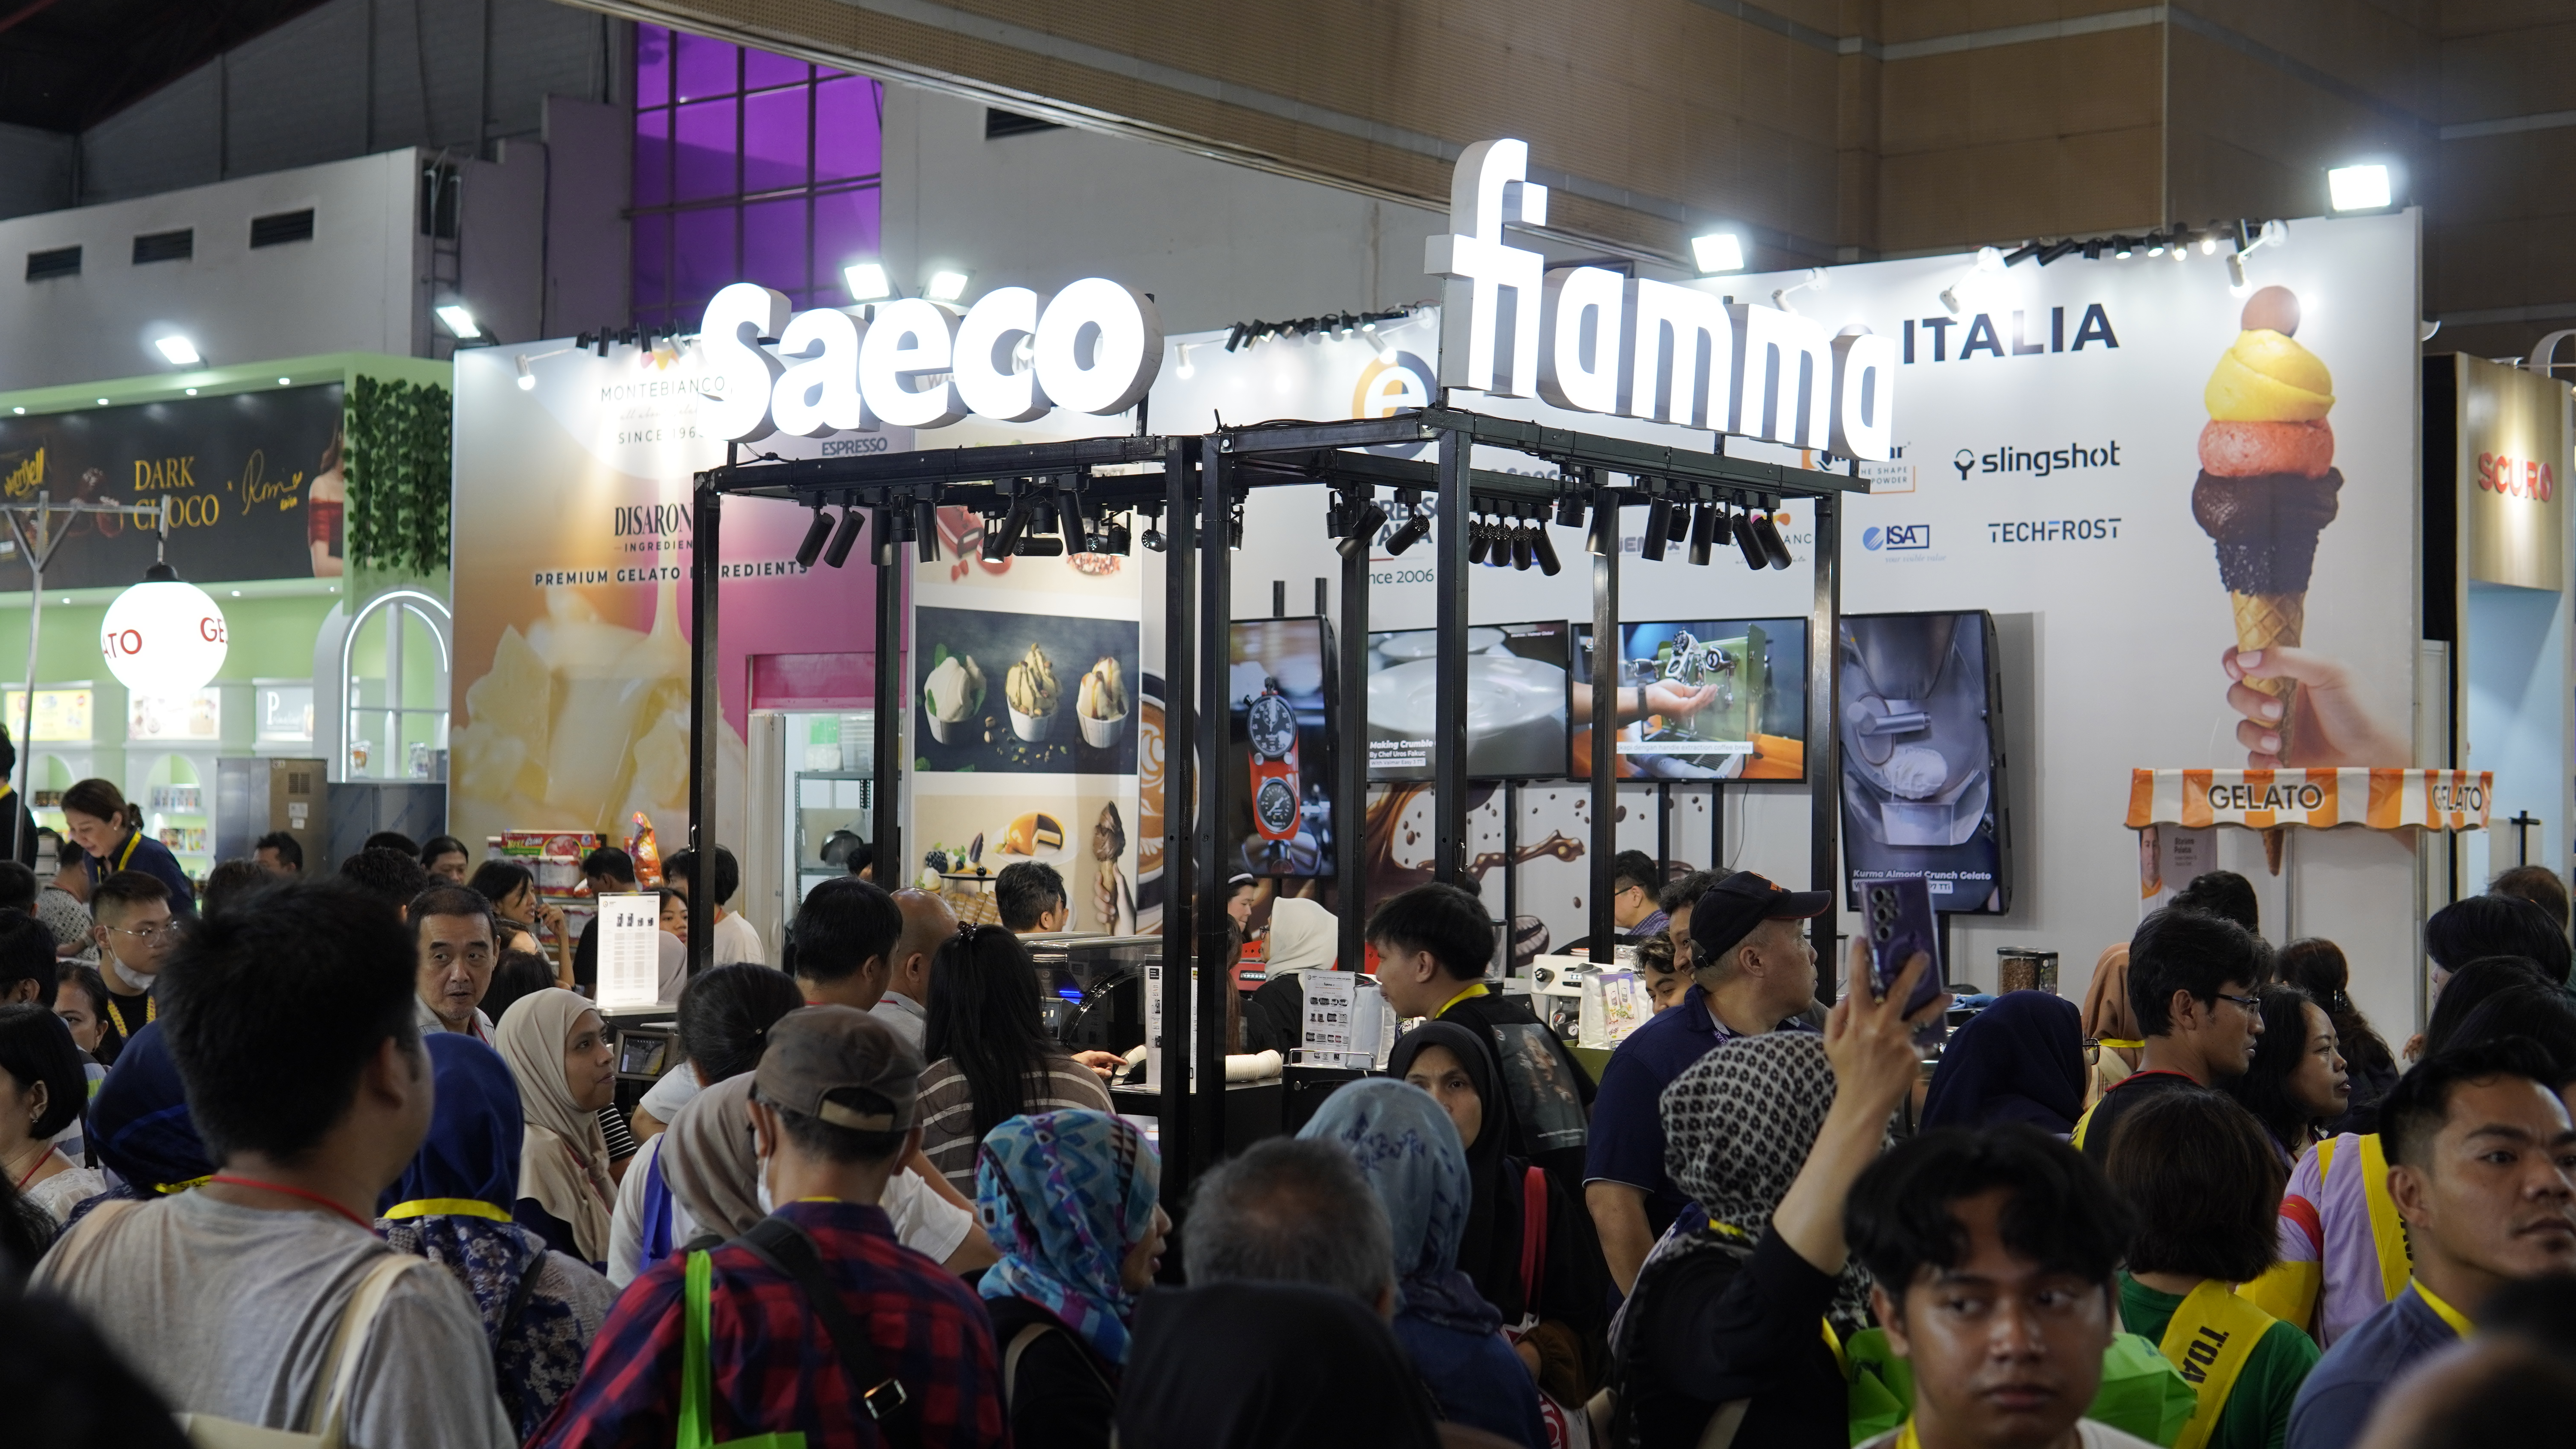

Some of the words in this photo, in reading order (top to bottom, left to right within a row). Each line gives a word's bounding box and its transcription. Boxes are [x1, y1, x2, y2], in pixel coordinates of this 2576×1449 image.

[1425, 138, 1896, 462] fiamma
[1903, 303, 2119, 364] ITALIA
[696, 277, 1164, 442] saeco
[601, 376, 725, 402] MONTEBIANCO
[618, 430, 662, 444] SINCE
[673, 426, 704, 439] 196
[822, 438, 888, 456] ESPRESSO
[1860, 467, 1873, 476] HE
[1877, 466, 1908, 475] SHAPE
[1981, 440, 2121, 477] slingshot
[134, 455, 195, 491] DARK
[1871, 475, 1908, 485] POWDER
[133, 494, 219, 530] COCO
[614, 502, 720, 536] DISARON
[1886, 526, 1917, 544] ISA
[1988, 518, 2122, 543] TECHFROST
[624, 540, 693, 552] INGREDIEN
[535, 571, 608, 586] PREMIUM
[617, 567, 680, 582] GELATO
[690, 561, 807, 578] IREDIENTS
[1370, 572, 1392, 584] nce
[1397, 569, 1434, 583] 2006
[1369, 740, 1399, 750] Making
[1400, 739, 1434, 748] Crumble
[2207, 782, 2324, 812] GELATO
[2432, 787, 2483, 812] GELATO
[1853, 870, 1882, 878] Kurma
[1924, 871, 1957, 879] Crunch
[1959, 871, 1992, 880] Gelato
